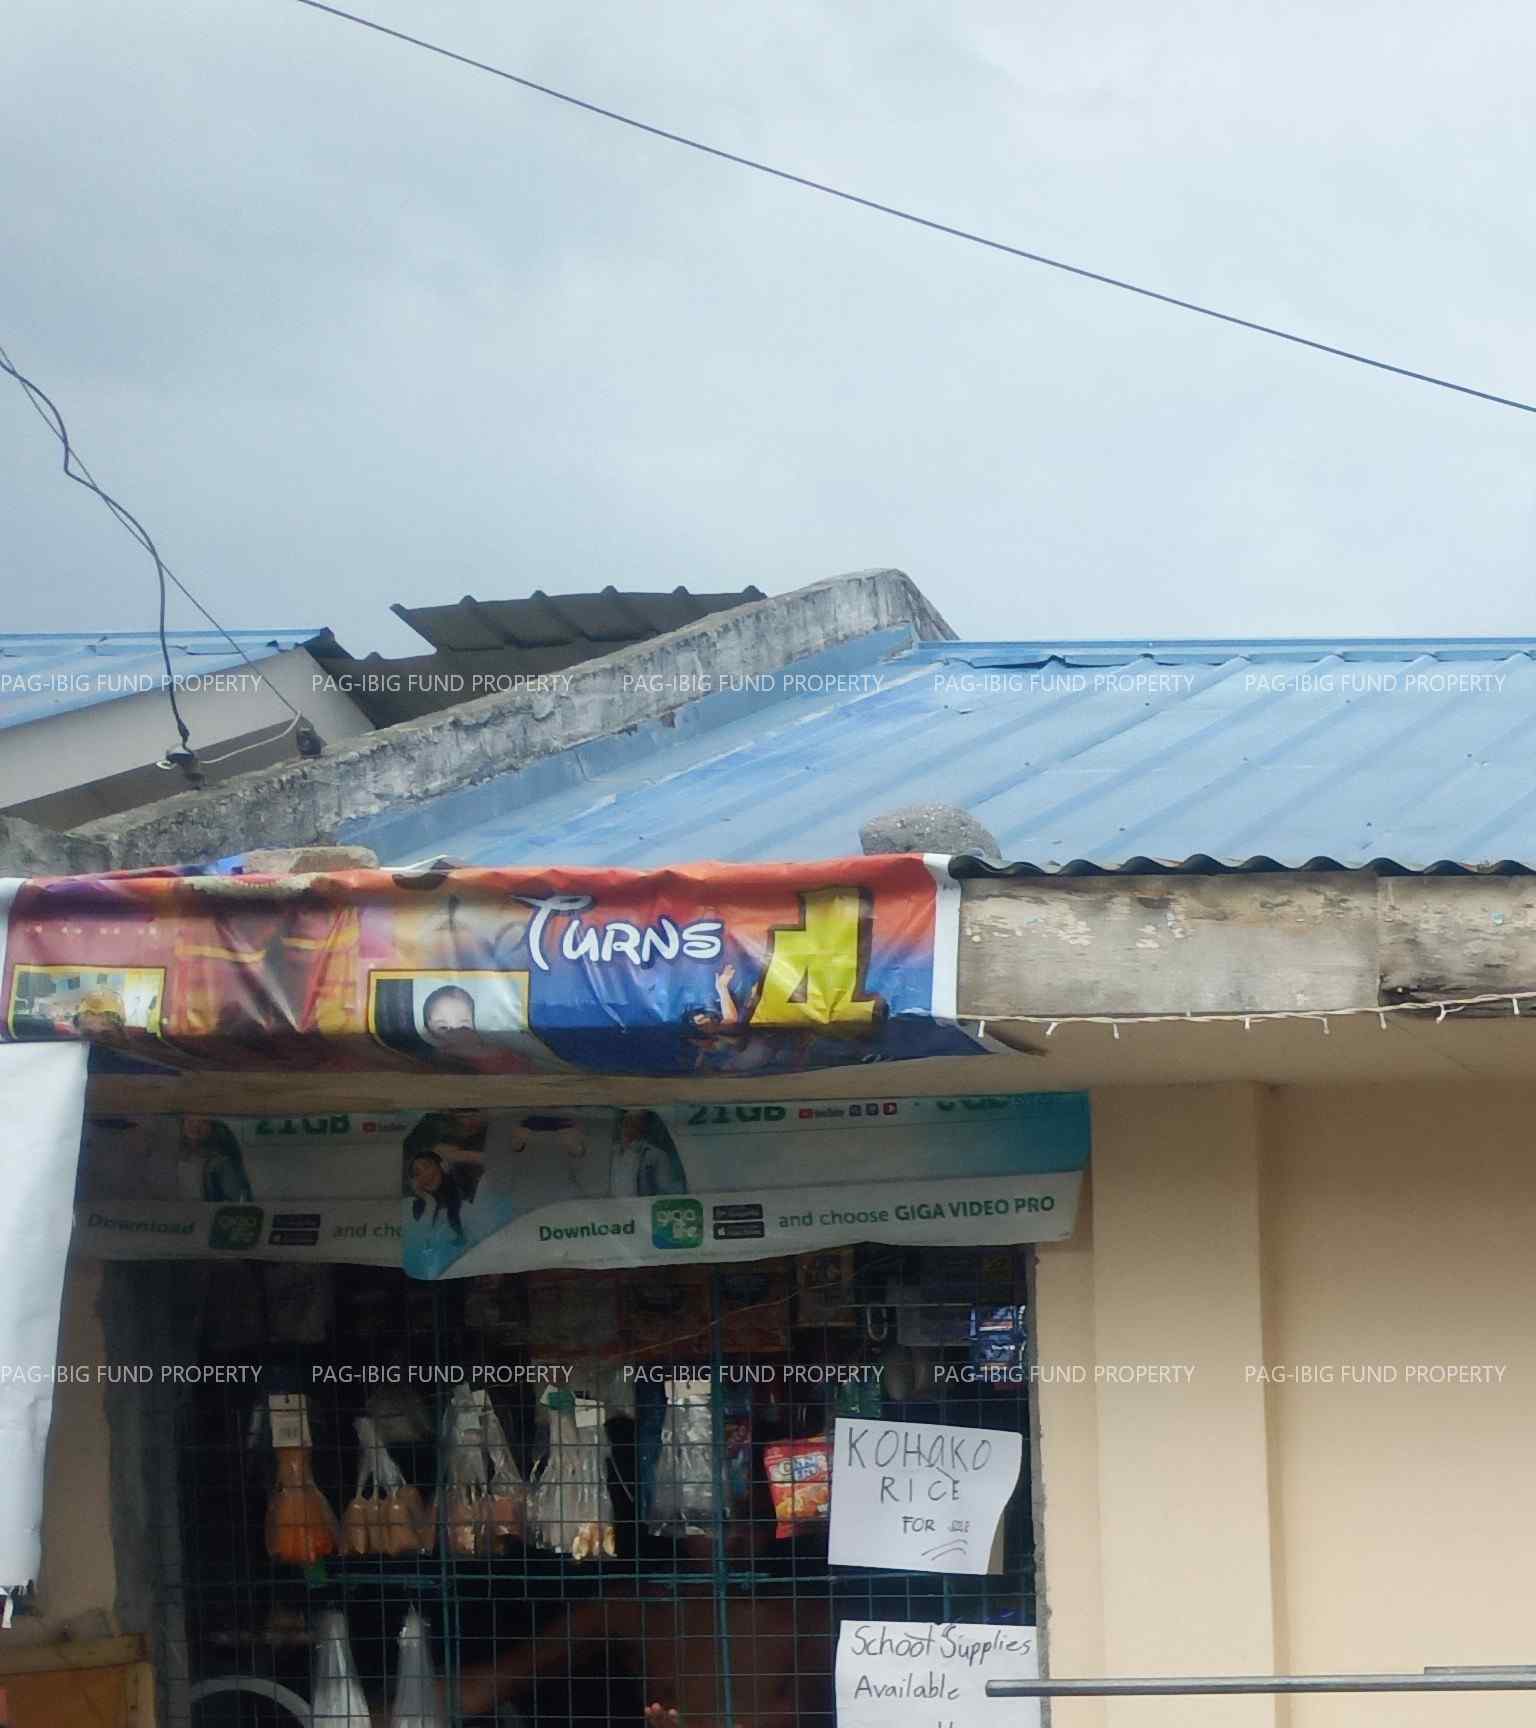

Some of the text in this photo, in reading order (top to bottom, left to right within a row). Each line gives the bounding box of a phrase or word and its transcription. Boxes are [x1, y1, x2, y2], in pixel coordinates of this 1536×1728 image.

[538, 1219, 636, 1242] Download
[777, 1209, 813, 1227] and
[819, 1206, 890, 1227] choose
[895, 1200, 946, 1222] GIGA
[948, 1198, 1009, 1219] VIDEO
[1013, 1195, 1056, 1215] PRO
[880, 1476, 961, 1504] RICE
[902, 1515, 936, 1534] FOR
[850, 1624, 1032, 1667] School Supplies
[854, 1671, 960, 1701] Available
